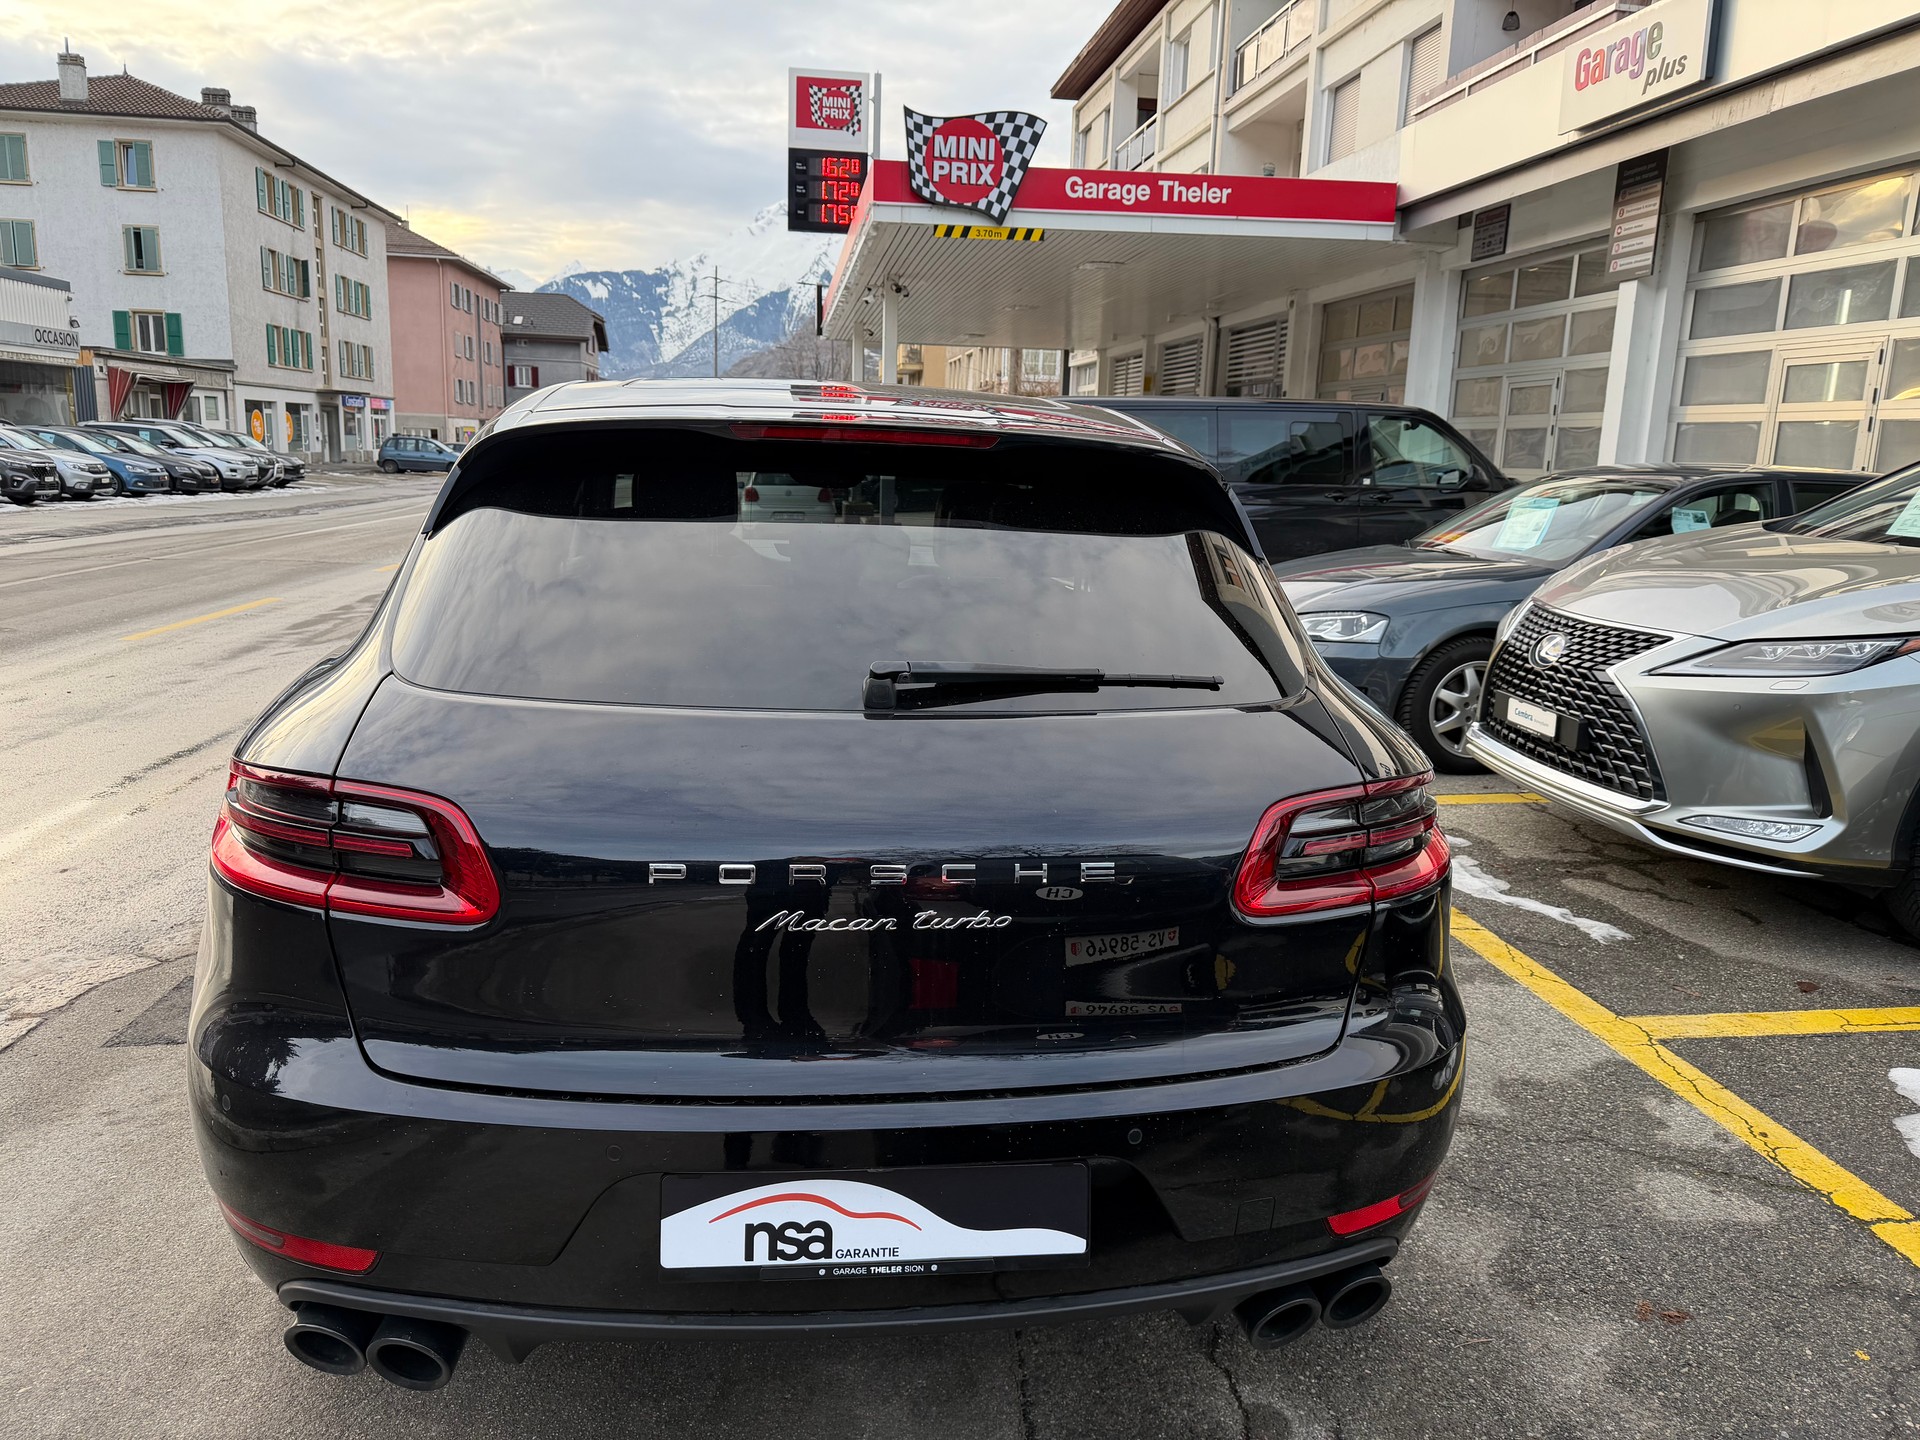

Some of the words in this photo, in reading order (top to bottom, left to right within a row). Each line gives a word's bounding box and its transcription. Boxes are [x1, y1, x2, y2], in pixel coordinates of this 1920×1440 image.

[1574, 21, 1663, 91] Garage
[1642, 54, 1688, 95] plus
[822, 96, 851, 109] MINI
[822, 108, 851, 120] PRIX
[933, 135, 996, 162] MINI
[932, 160, 995, 186] PRIX
[1065, 176, 1151, 205] Garage
[1158, 180, 1232, 204] Theler
[35, 328, 79, 347] OCCASION
[650, 864, 1116, 884] PORSCHE
[754, 909, 898, 932] Macan
[913, 910, 1013, 930] turbo
[744, 1220, 834, 1262] nsa
[836, 1247, 899, 1258] GARANTIE
[832, 1267, 867, 1276] GARAGE
[870, 1265, 902, 1275] THELER
[904, 1265, 924, 1274] SION
